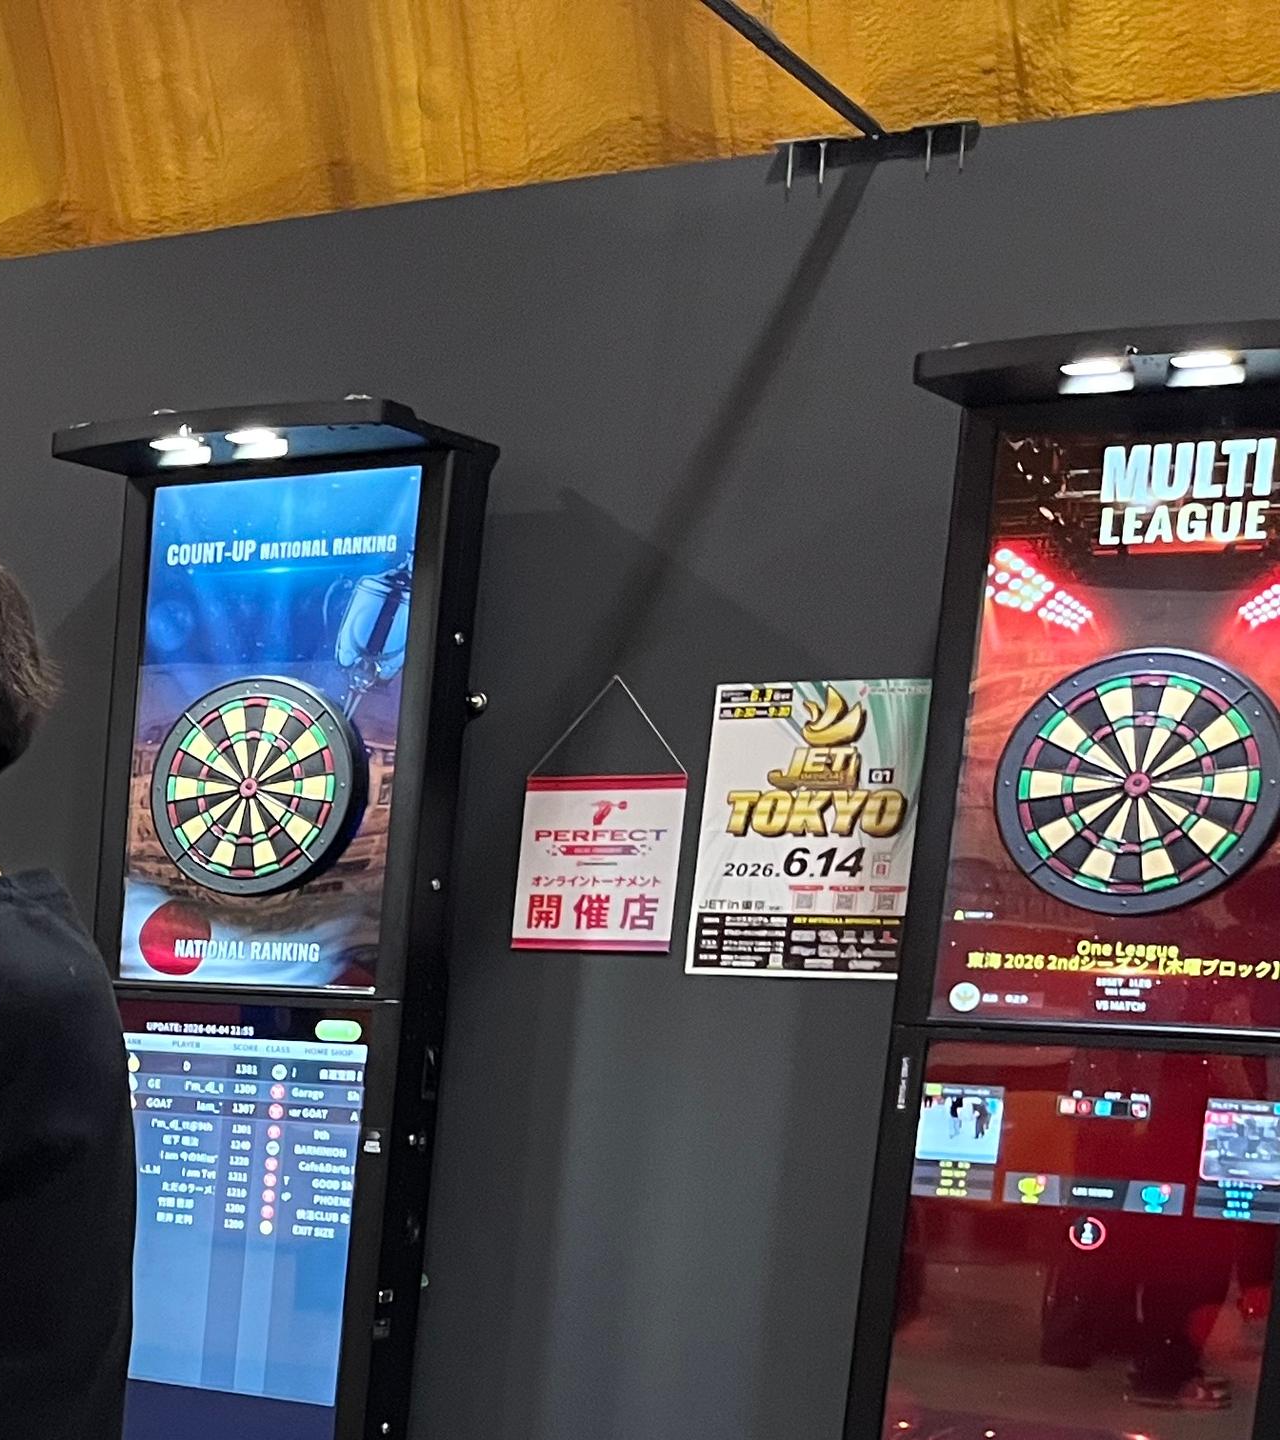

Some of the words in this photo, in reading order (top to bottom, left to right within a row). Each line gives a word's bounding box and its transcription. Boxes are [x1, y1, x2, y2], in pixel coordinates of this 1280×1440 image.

[1100, 437, 1277, 503] MULTI
[1099, 500, 1270, 545] LEAGUE
[167, 540, 256, 566] COUNT-UP
[260, 539, 328, 560] NATIONAL
[333, 535, 397, 556] RANKING
[768, 747, 857, 788] JET
[726, 789, 907, 838] TOKYO
[534, 829, 667, 841] PERFECT
[531, 876, 661, 887] オンライントーナメント
[527, 893, 659, 930] 開催店
[174, 939, 245, 959] NATIONAL
[251, 942, 320, 962] RANKING
[1003, 954, 1045, 969] 2026
[1077, 940, 1112, 957] One
[1115, 941, 1179, 962] League
[172, 1040, 200, 1048] PLAYER
[233, 1043, 258, 1052] SCORE
[266, 1045, 291, 1053] CLASS
[331, 1049, 353, 1057] SHOP
[146, 1097, 173, 1109] GOAT
[302, 1108, 328, 1119] GOAT
